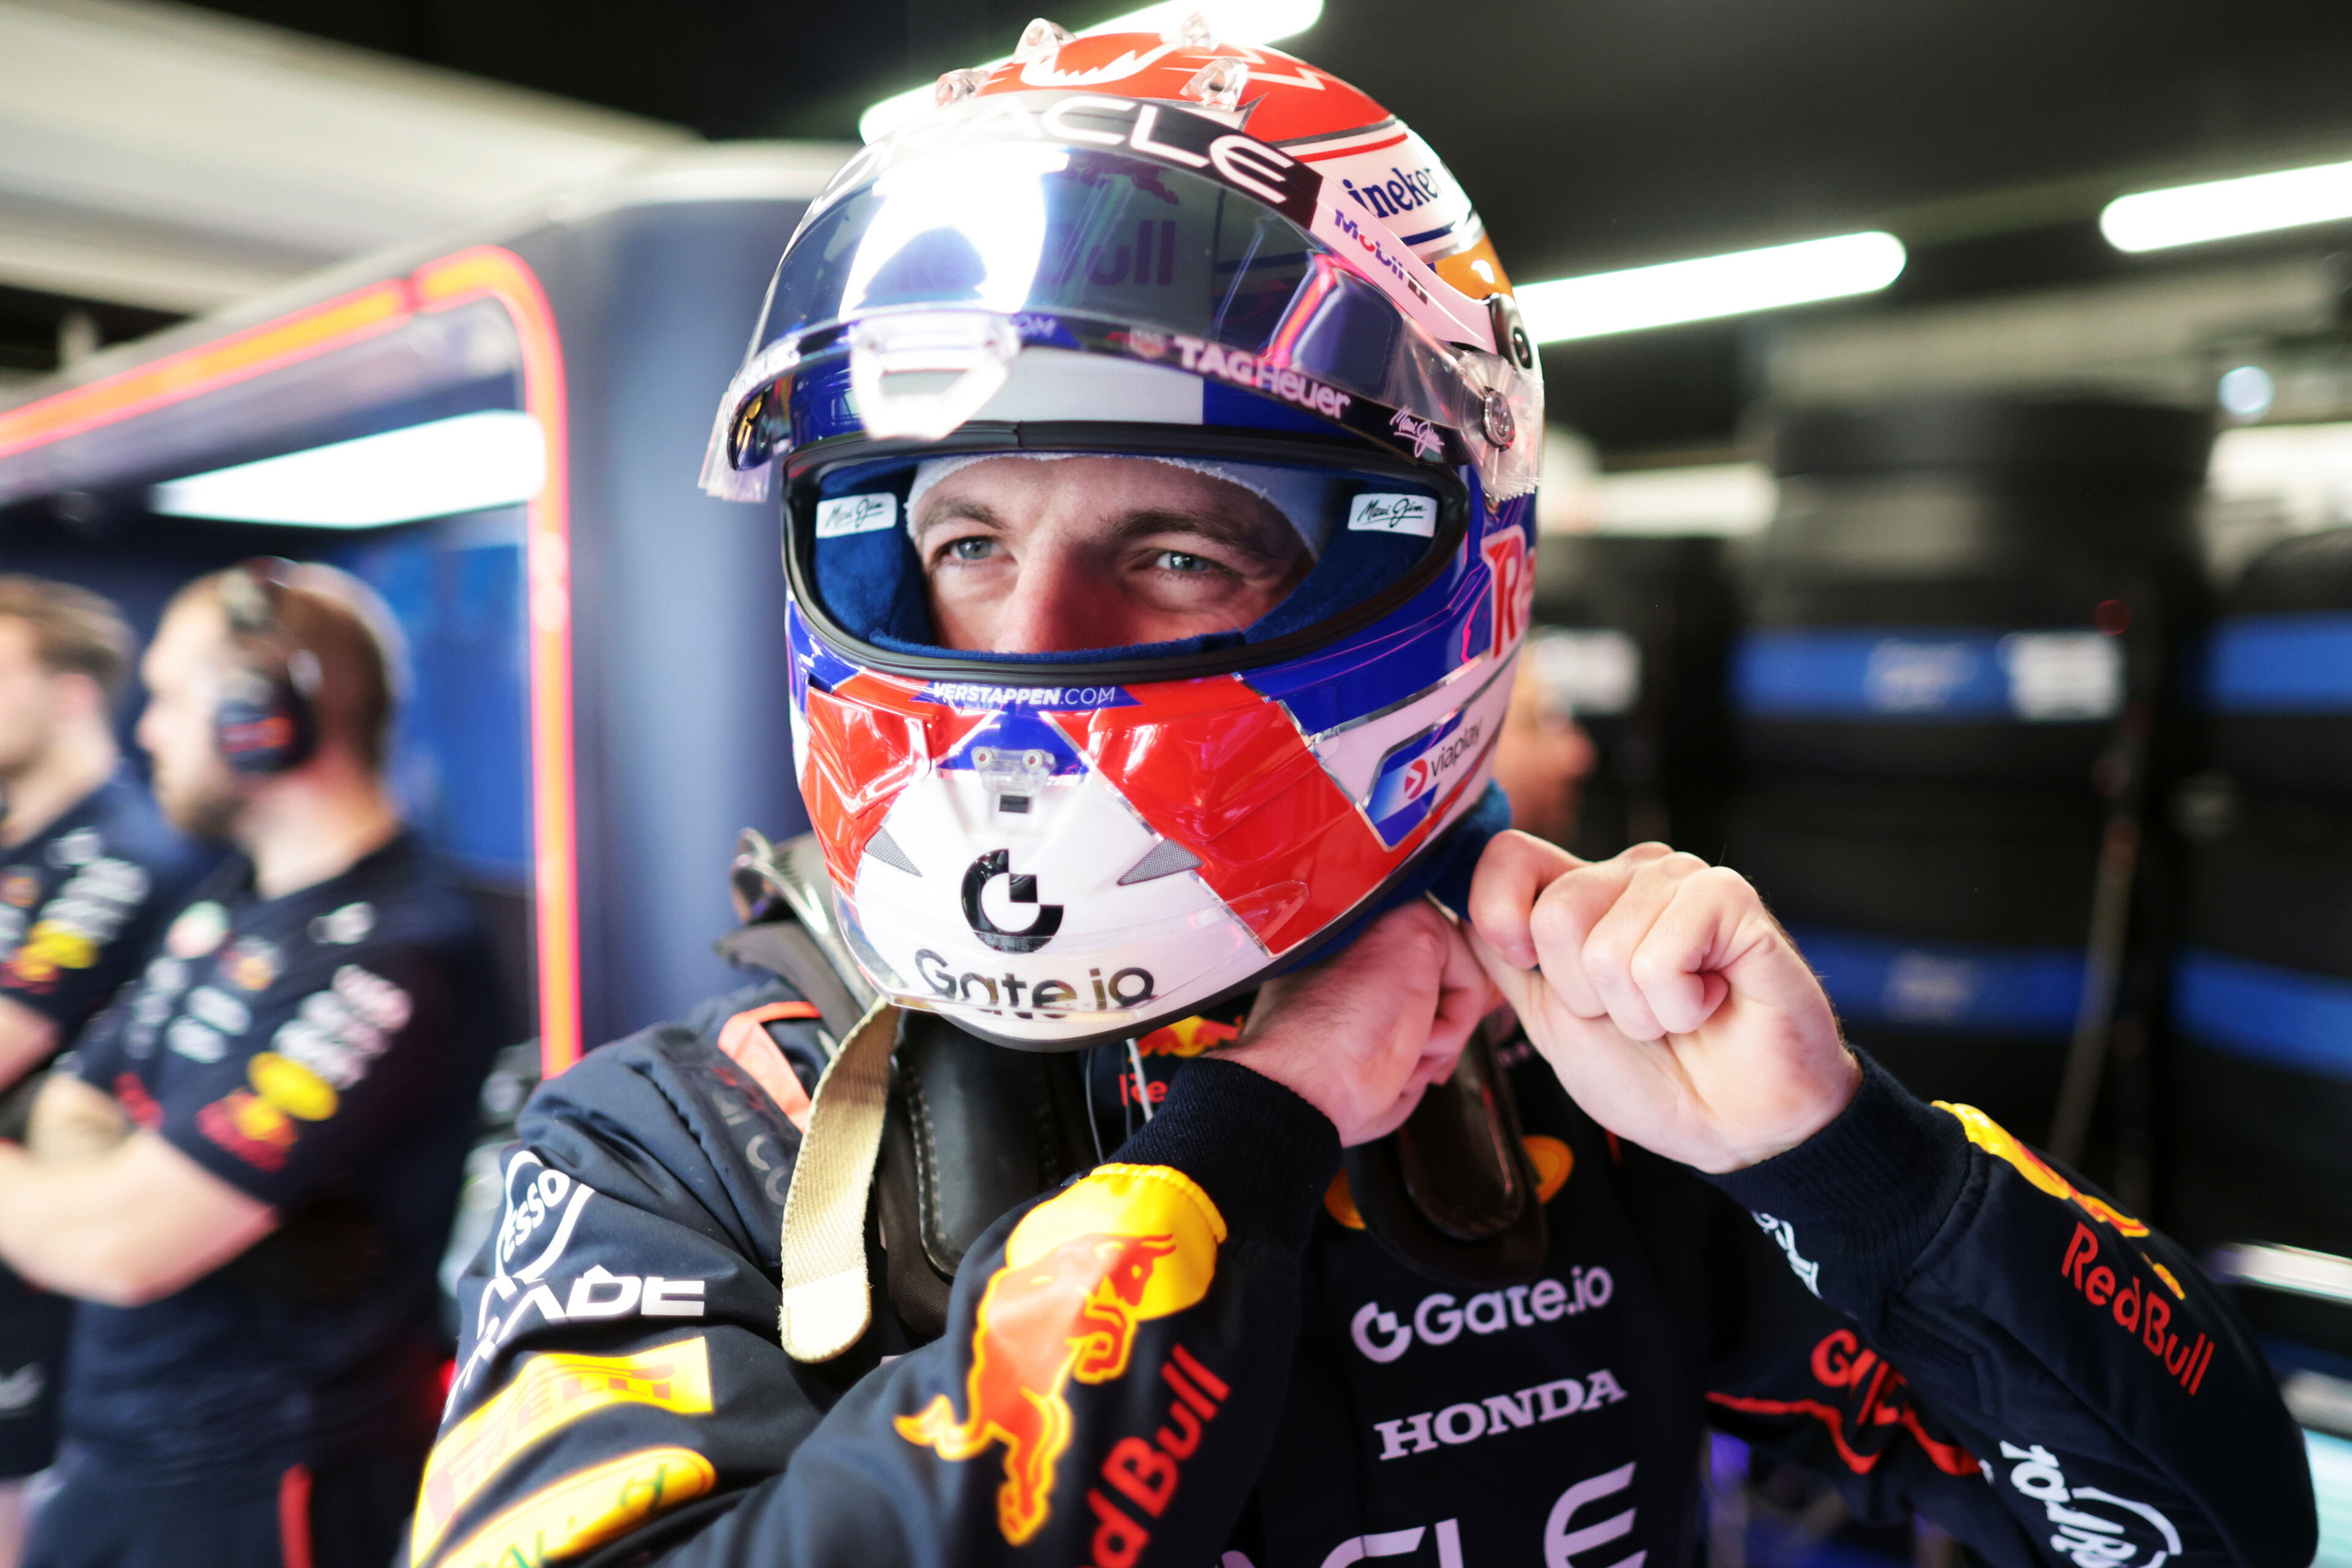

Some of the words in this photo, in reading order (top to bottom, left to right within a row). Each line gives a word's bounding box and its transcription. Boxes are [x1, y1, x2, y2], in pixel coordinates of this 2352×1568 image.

[1334, 208, 1404, 281] Mobil
[933, 682, 1116, 706] VERSTAPPEN.COM
[1414, 1265, 1614, 1346] Gate.io
[1374, 1368, 1628, 1461] HONDA
